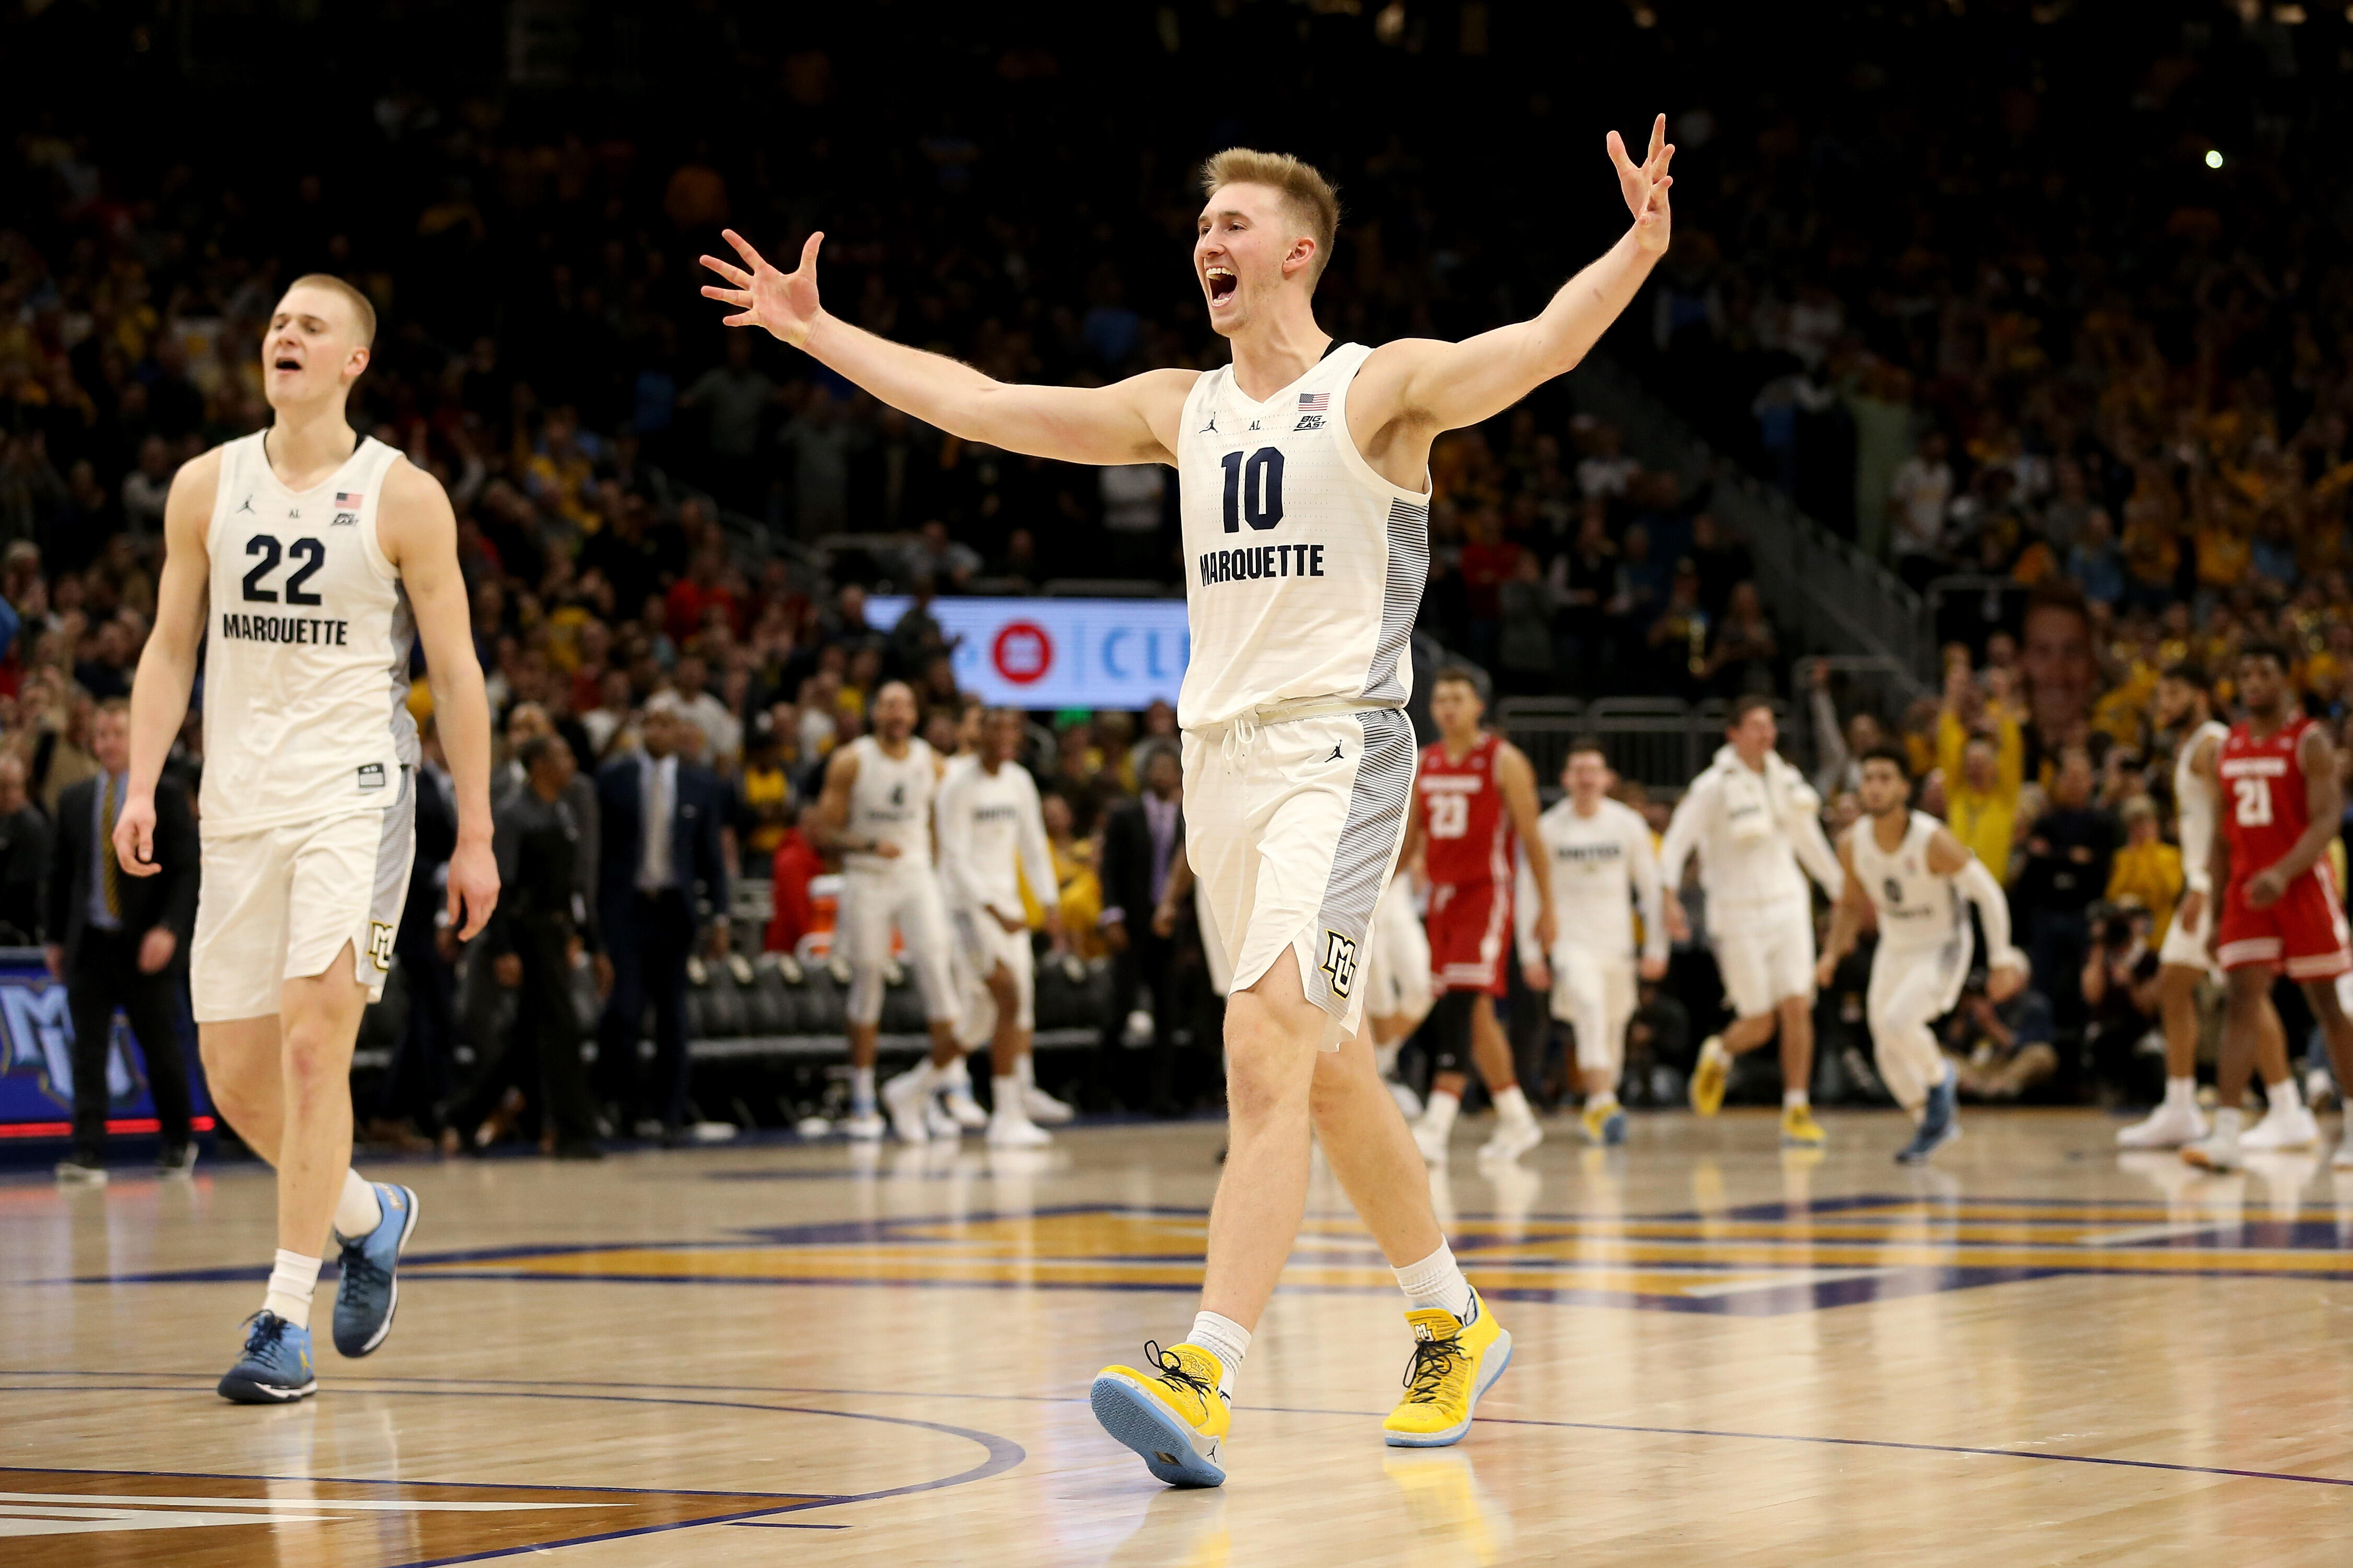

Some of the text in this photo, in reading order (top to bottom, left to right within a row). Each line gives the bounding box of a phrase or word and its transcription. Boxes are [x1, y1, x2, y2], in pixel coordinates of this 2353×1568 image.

[1249, 420, 1261, 431] AL
[1221, 447, 1285, 533] 10
[243, 534, 325, 605] 22
[1200, 544, 1324, 587] MARQUETTE
[223, 613, 348, 646] MARQUETTE
[1427, 793, 1470, 839] 23
[2233, 779, 2273, 826] 21
[1322, 930, 1356, 999] MU
[1414, 1323, 1436, 1342] MU
